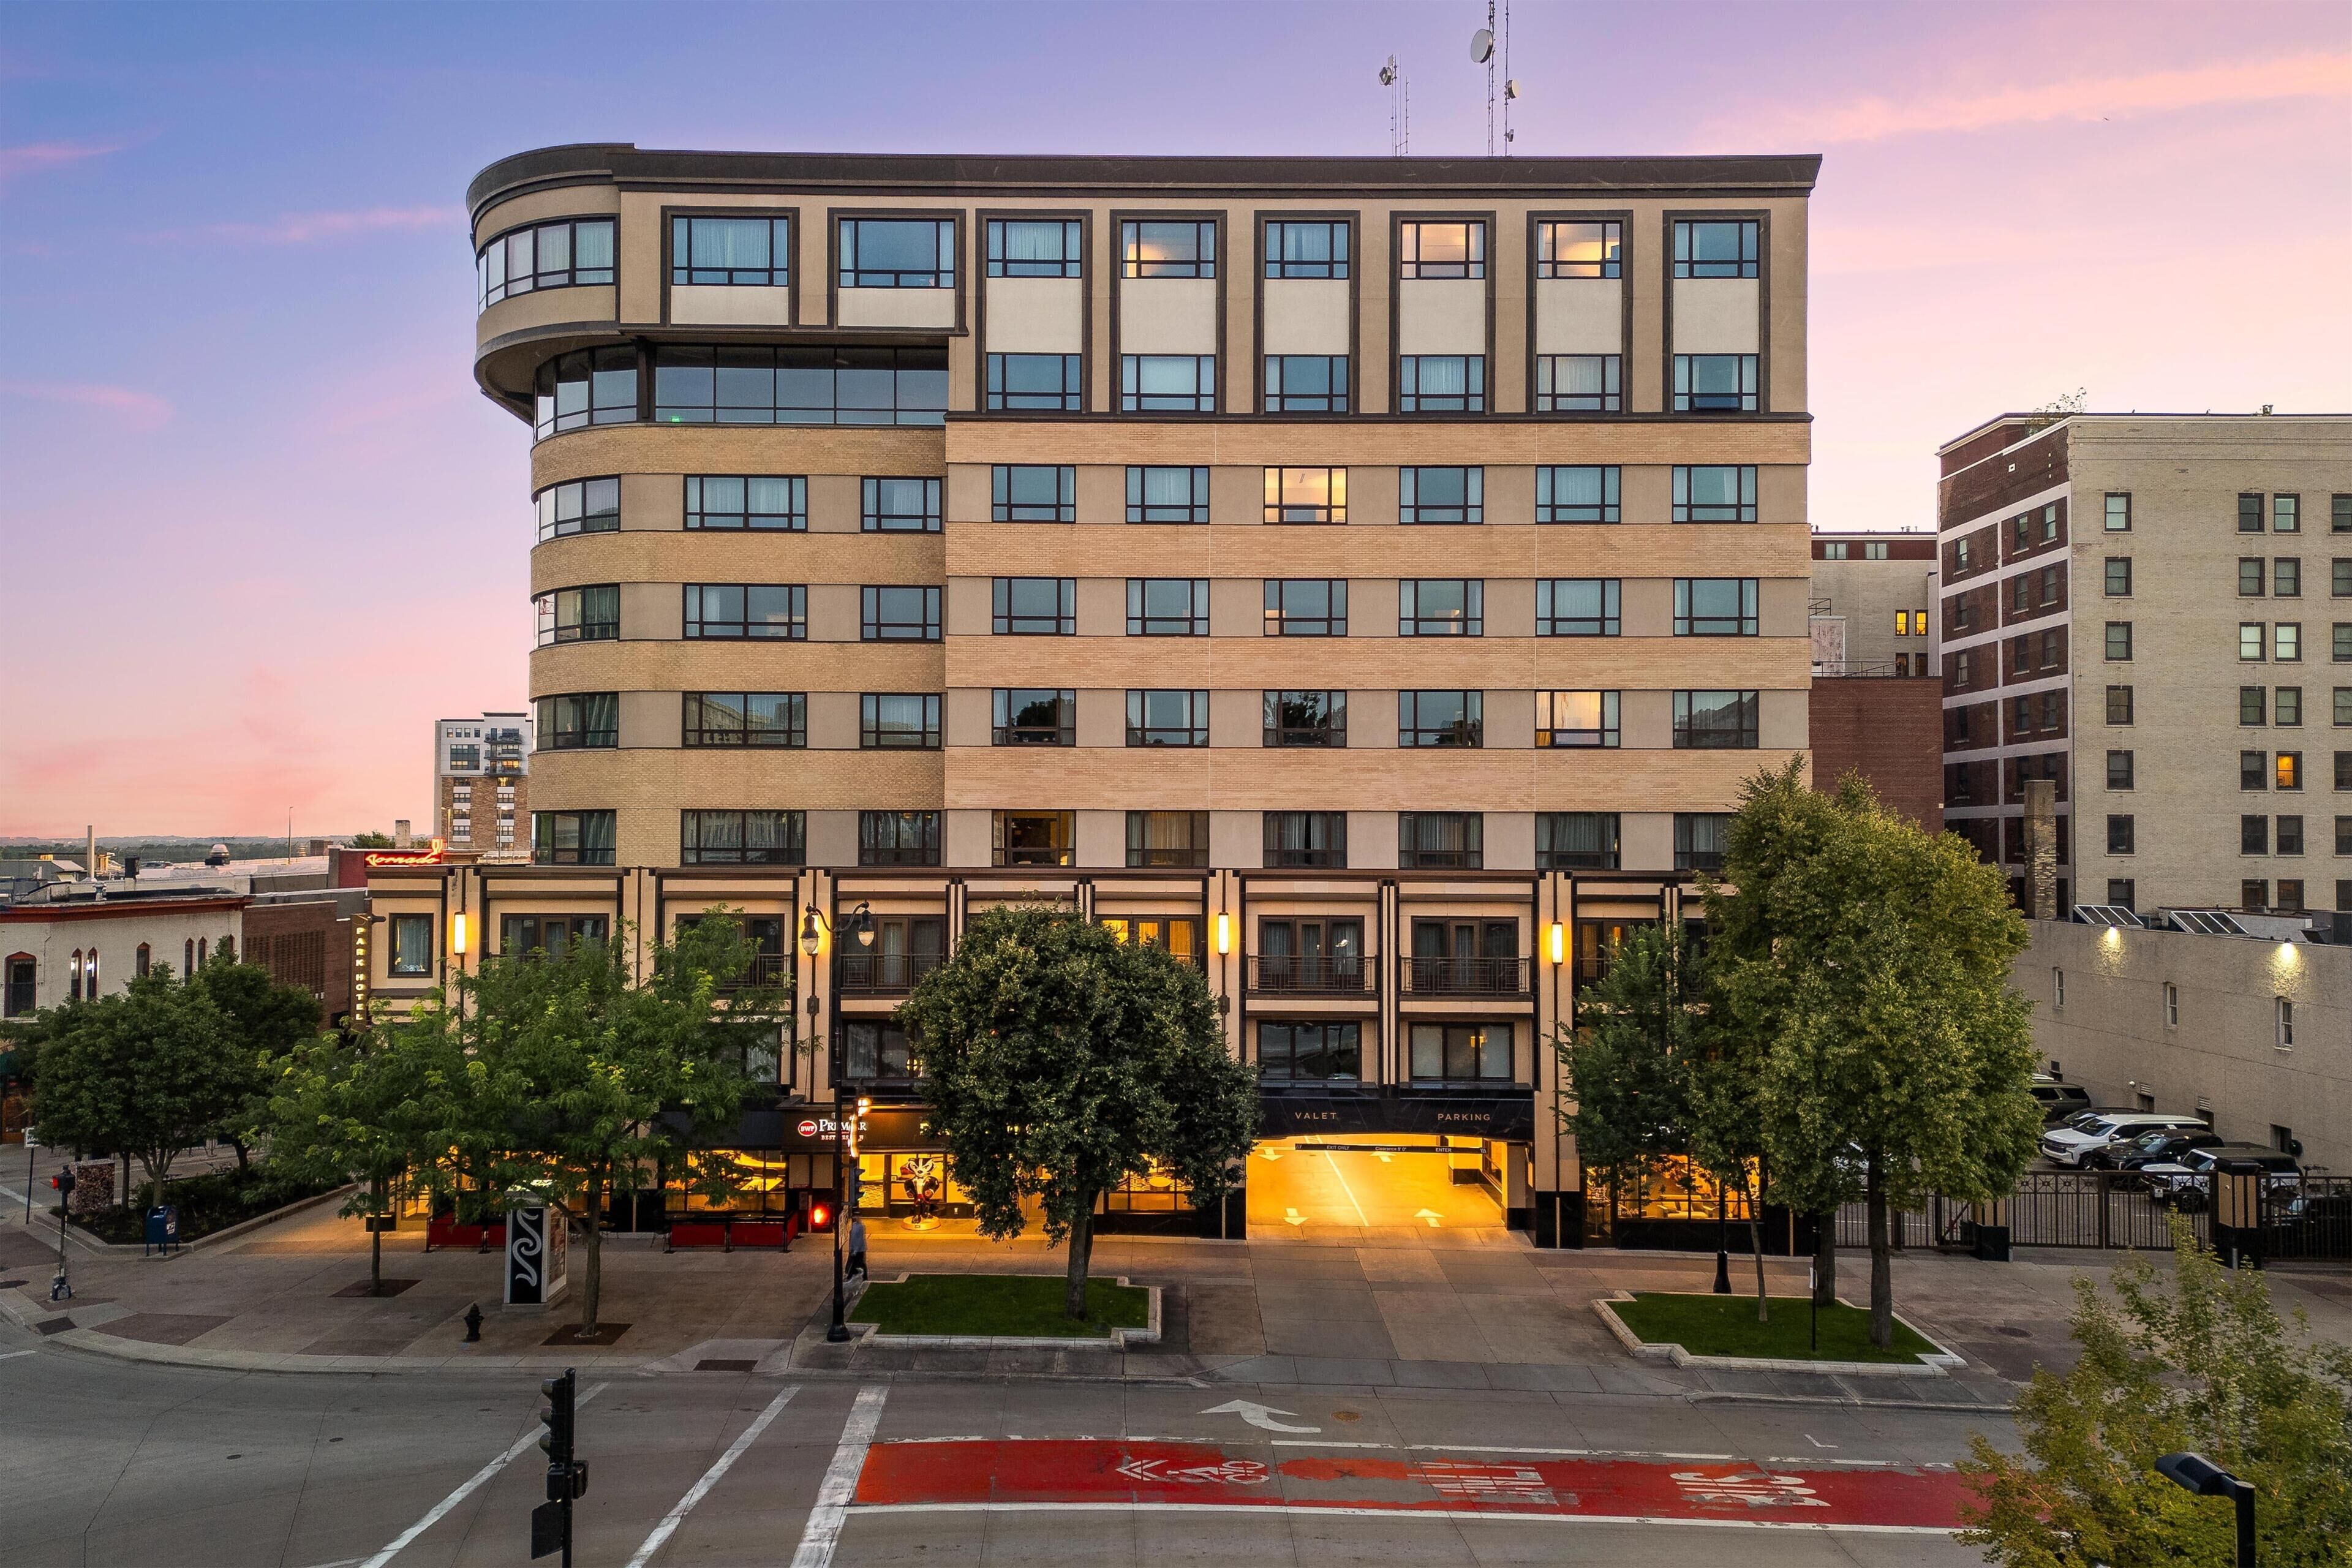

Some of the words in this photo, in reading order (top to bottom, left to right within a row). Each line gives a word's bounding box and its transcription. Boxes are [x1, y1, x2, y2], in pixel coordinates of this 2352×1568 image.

[356, 927, 366, 967] PARK
[355, 973, 366, 1020] HOTEL
[818, 1119, 867, 1132] PRMR
